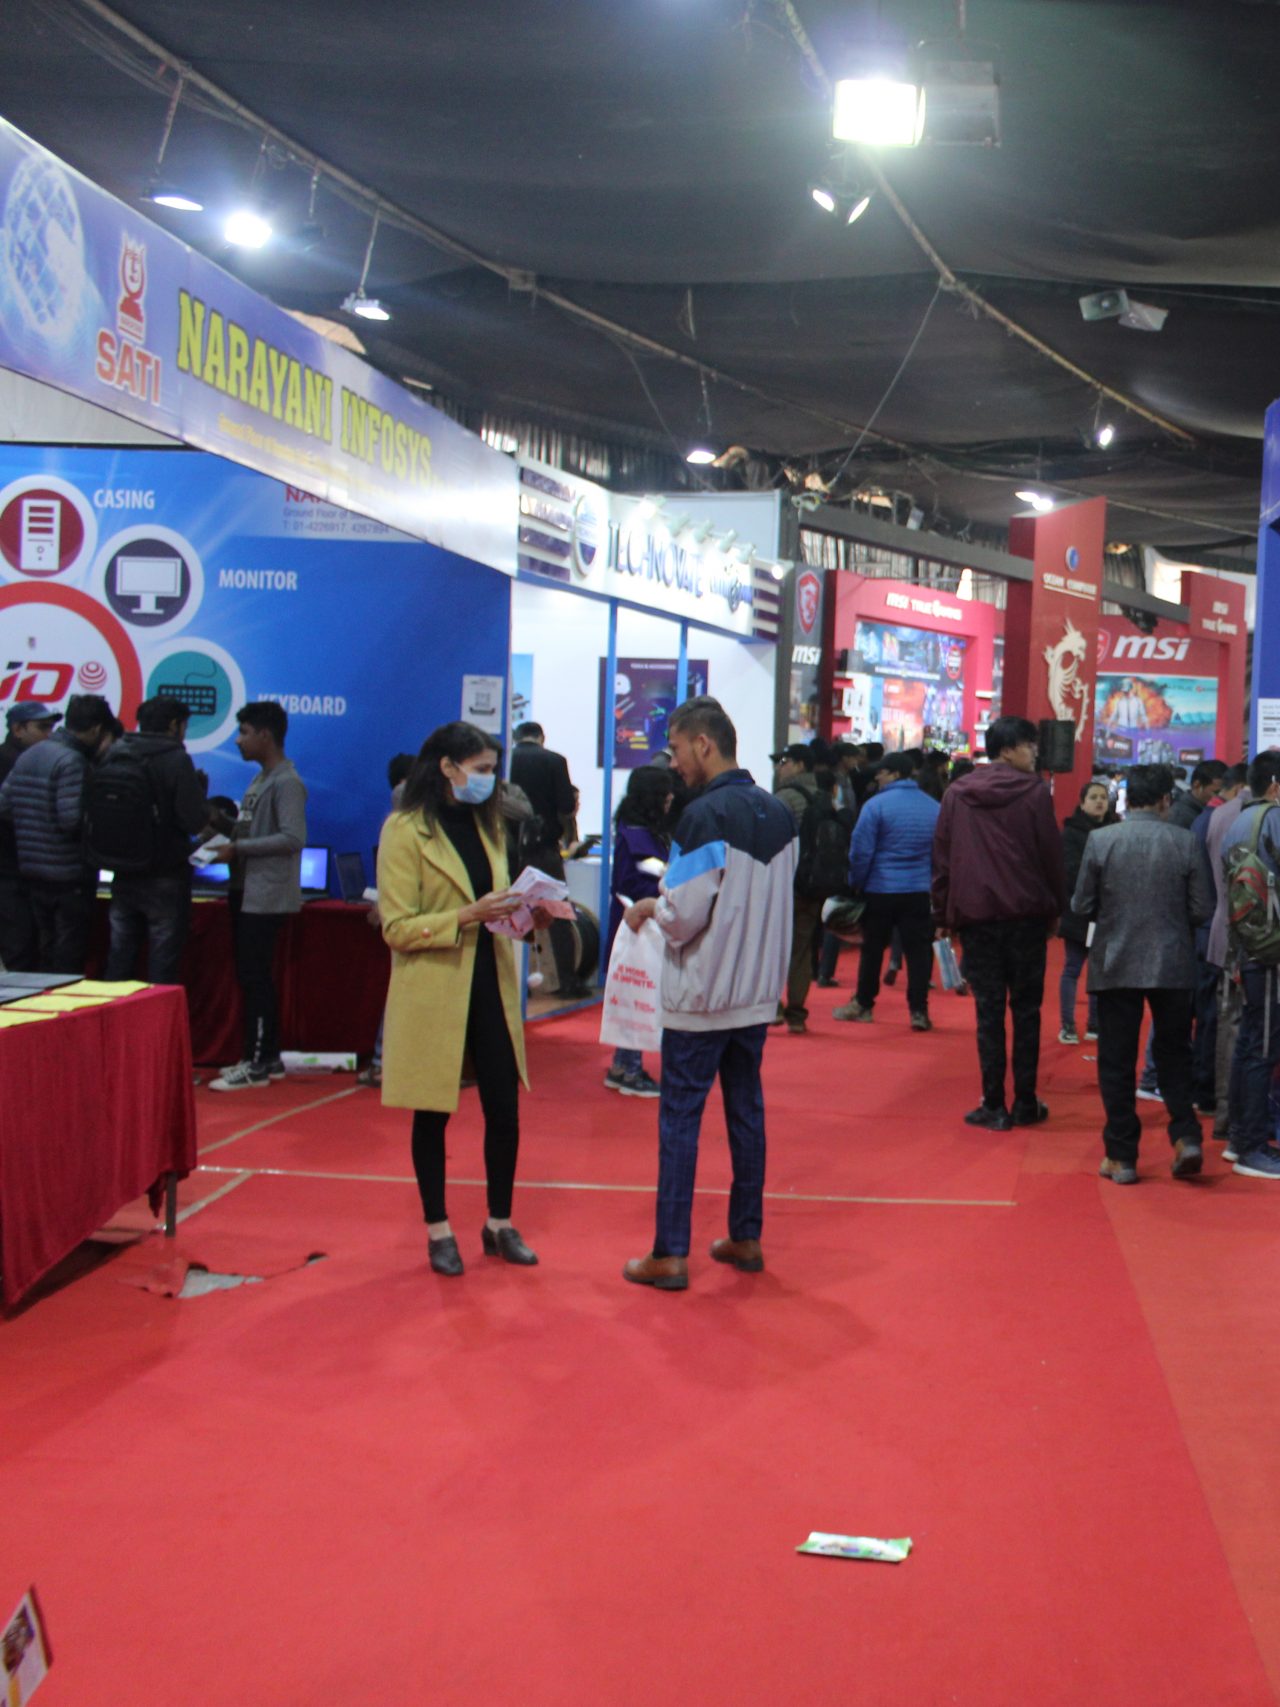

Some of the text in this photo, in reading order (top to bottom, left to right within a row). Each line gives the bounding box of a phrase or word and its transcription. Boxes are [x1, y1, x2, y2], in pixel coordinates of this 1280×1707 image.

[96, 327, 161, 404] SATI
[177, 286, 333, 446] NARAYANI
[93, 488, 156, 510] CASING
[219, 568, 299, 591] MONITOR
[791, 644, 822, 666] msi
[1112, 634, 1192, 662] msi
